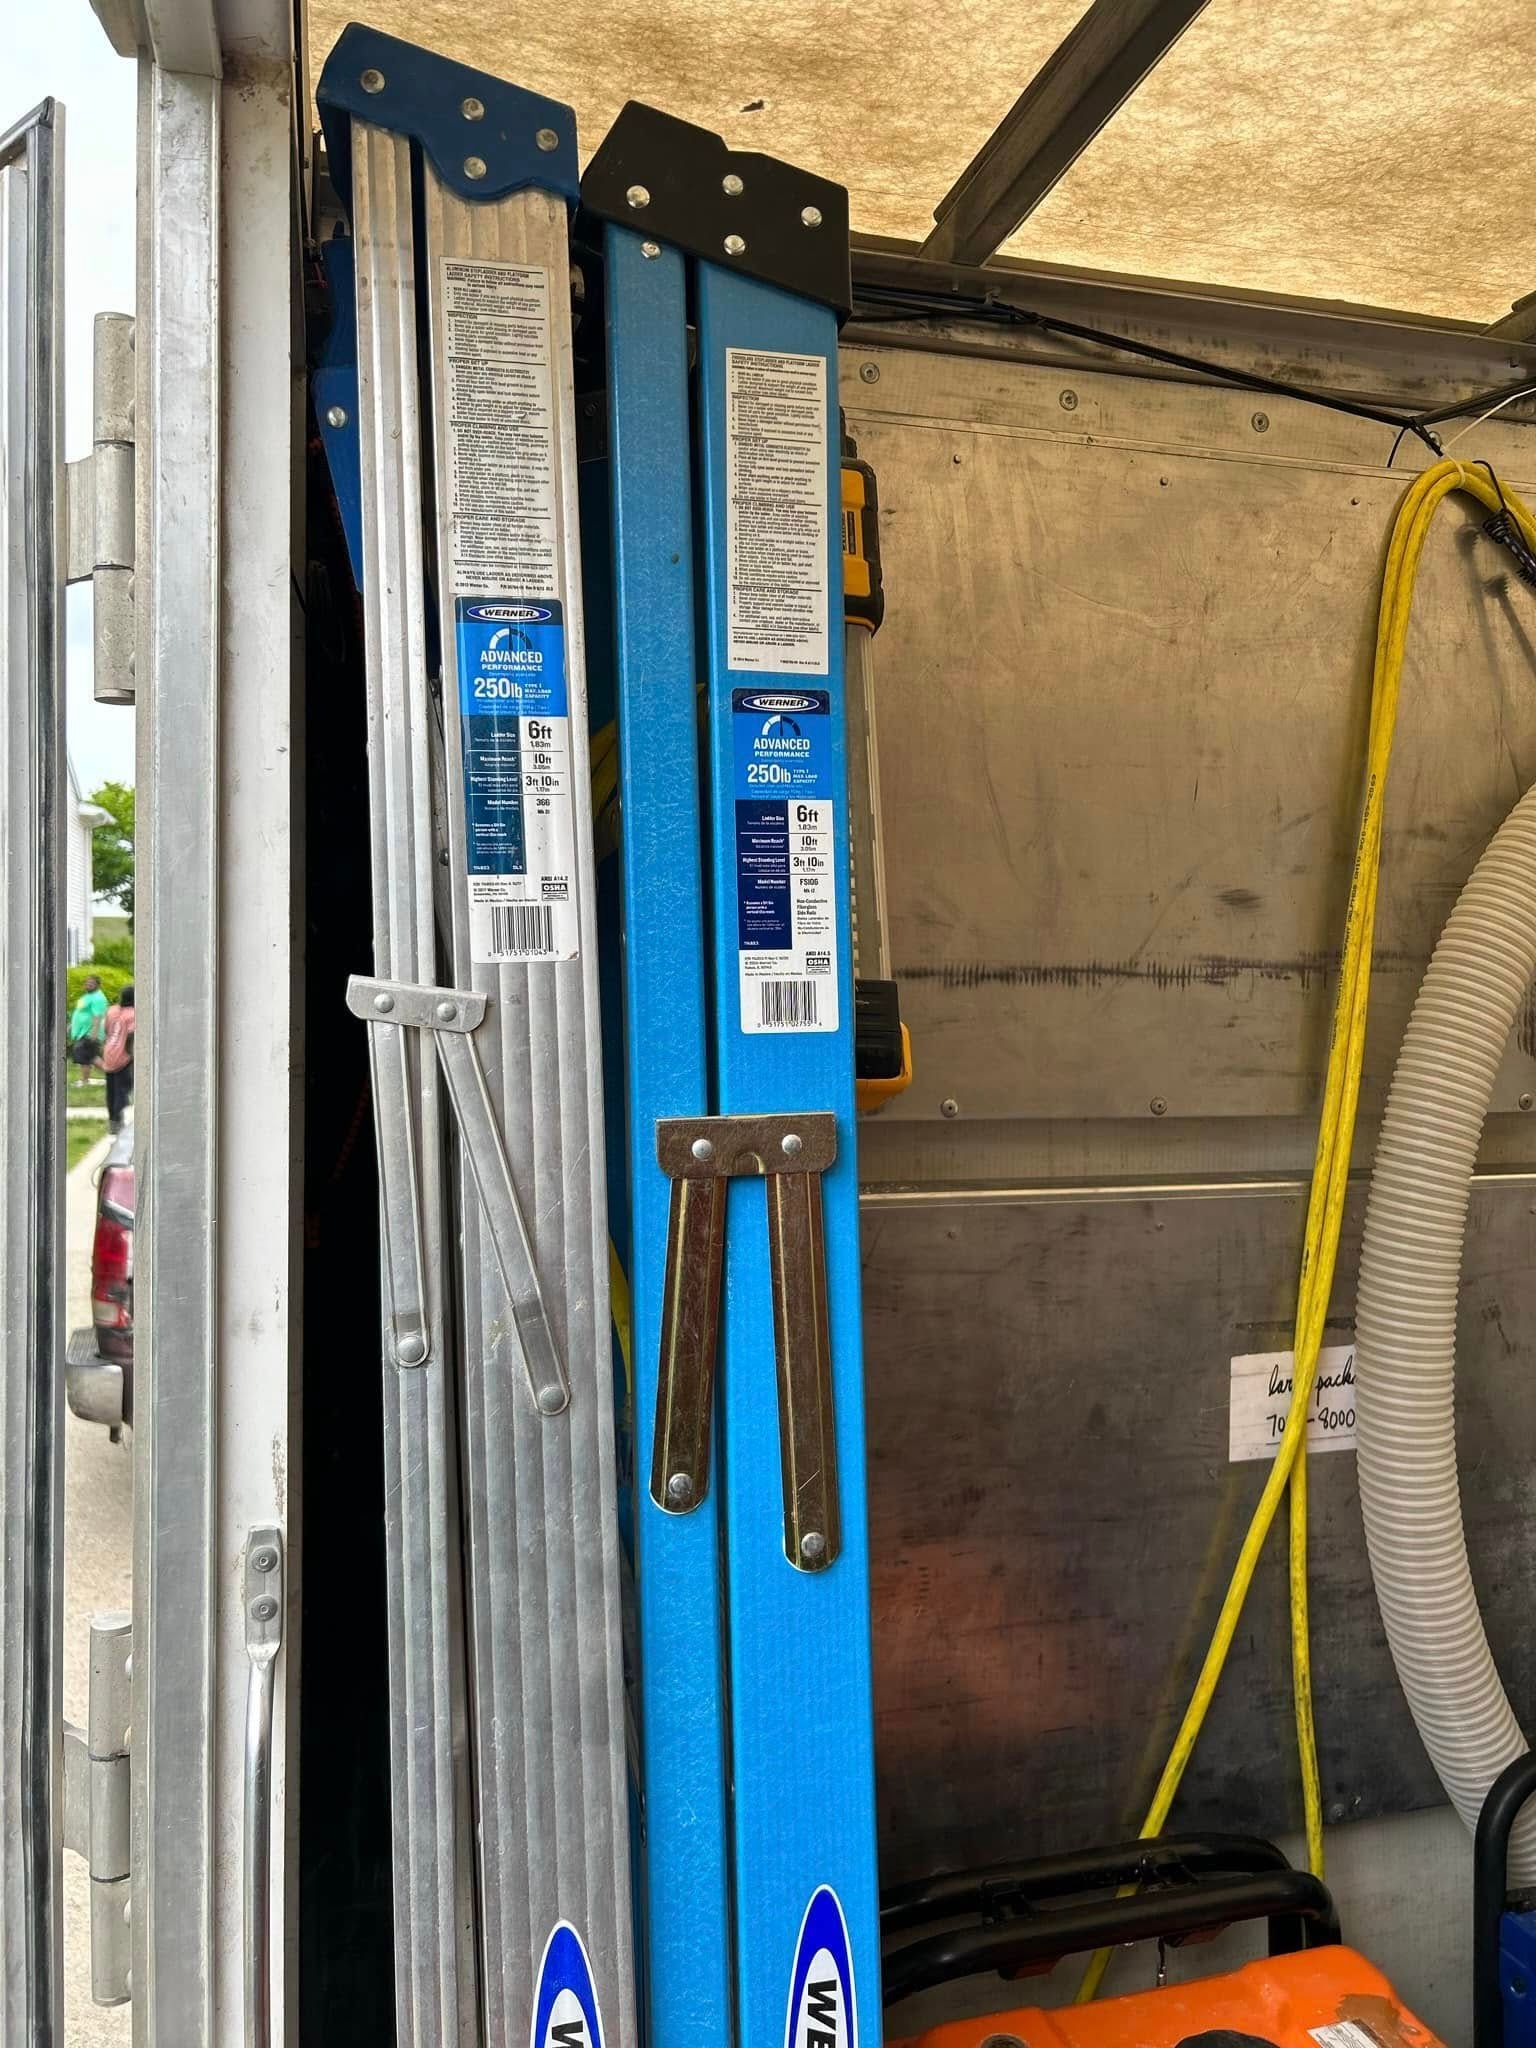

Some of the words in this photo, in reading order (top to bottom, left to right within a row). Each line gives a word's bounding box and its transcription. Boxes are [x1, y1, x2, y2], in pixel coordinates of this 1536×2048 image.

[484, 609, 535, 617] WERNER
[480, 651, 542, 663] ADVANCED
[474, 677, 522, 698] 250lb
[528, 721, 552, 739] 6ft
[754, 739, 810, 750] ADVANCED
[535, 753, 552, 764] 10ft
[747, 764, 791, 783] 250lb
[526, 776, 538, 786] 3ft
[541, 776, 559, 786] 10in
[797, 805, 818, 823] 6ft
[802, 836, 817, 846] 10ft
[793, 857, 805, 867] 3ft
[808, 857, 824, 867] 10in
